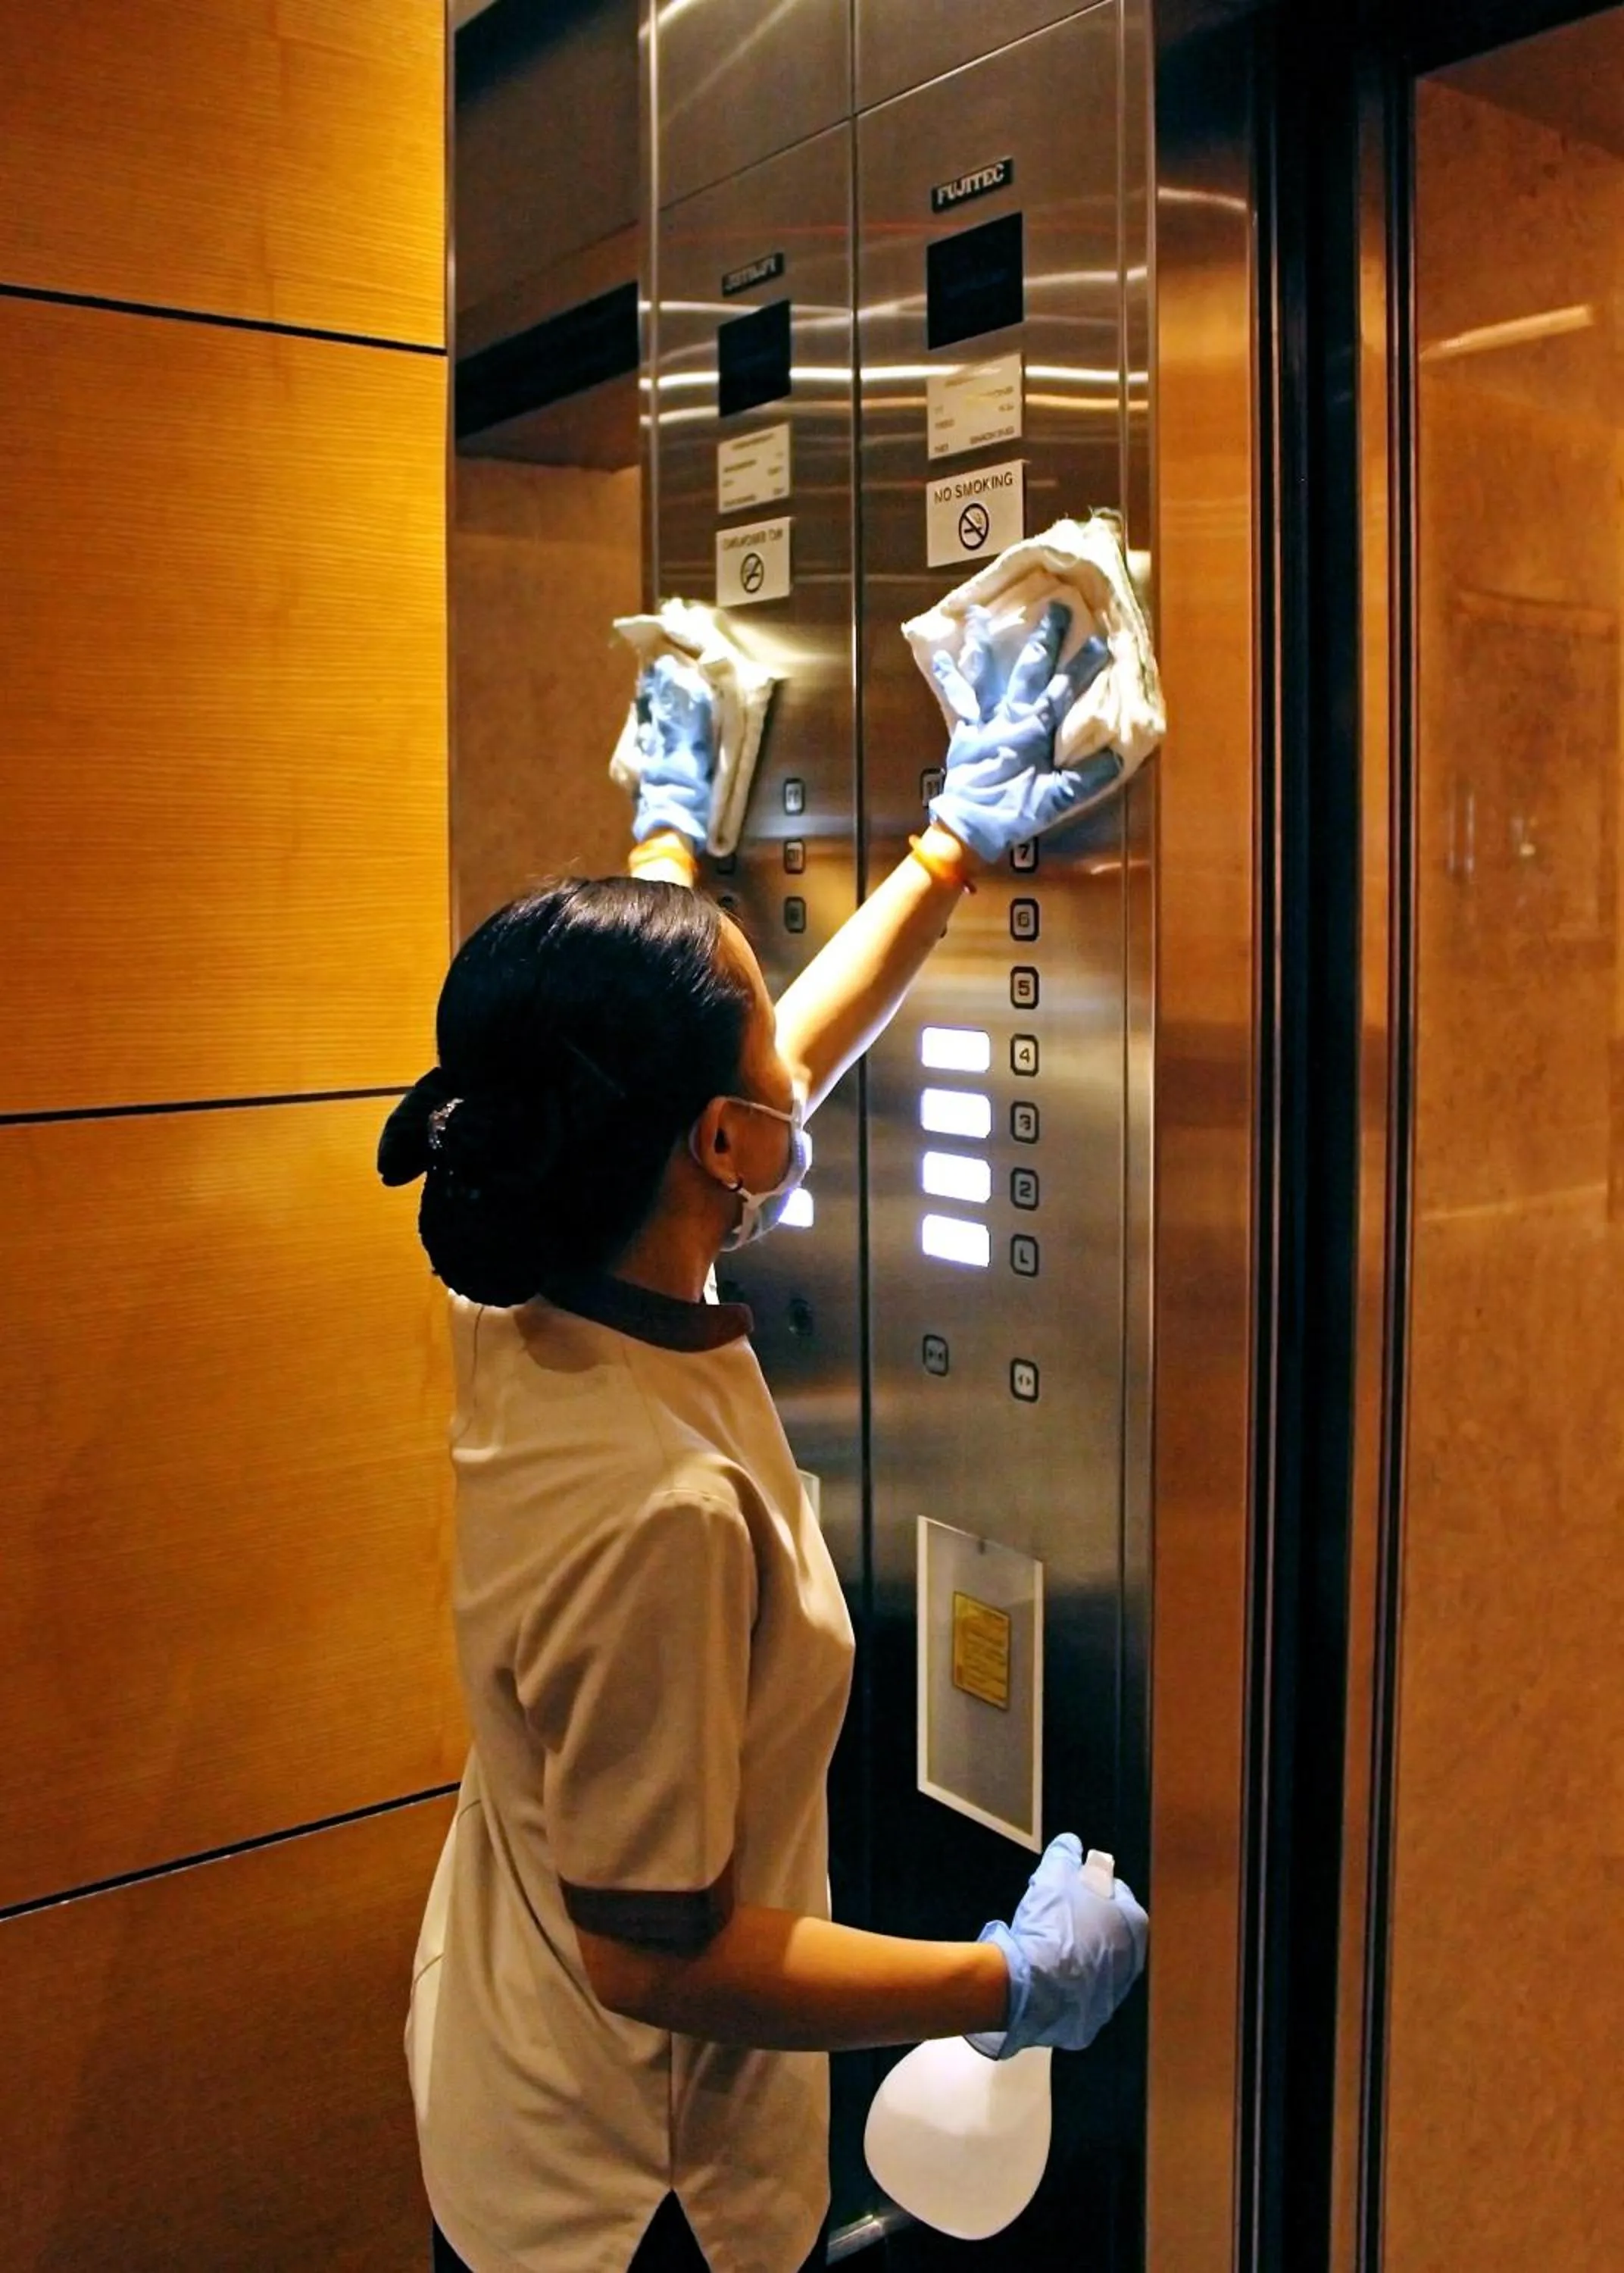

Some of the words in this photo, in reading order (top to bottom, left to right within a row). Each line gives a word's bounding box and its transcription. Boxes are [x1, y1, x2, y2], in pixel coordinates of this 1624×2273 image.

[938, 164, 1004, 205] FUJITEC
[934, 487, 952, 503] NO
[955, 471, 1013, 499] SMOKING
[1018, 843, 1030, 860] 7
[1017, 980, 1030, 996] 5
[1019, 1047, 1031, 1064] 4
[1019, 1114, 1032, 1131] 3
[1020, 1180, 1031, 1198] 2
[1020, 1247, 1029, 1265] L
